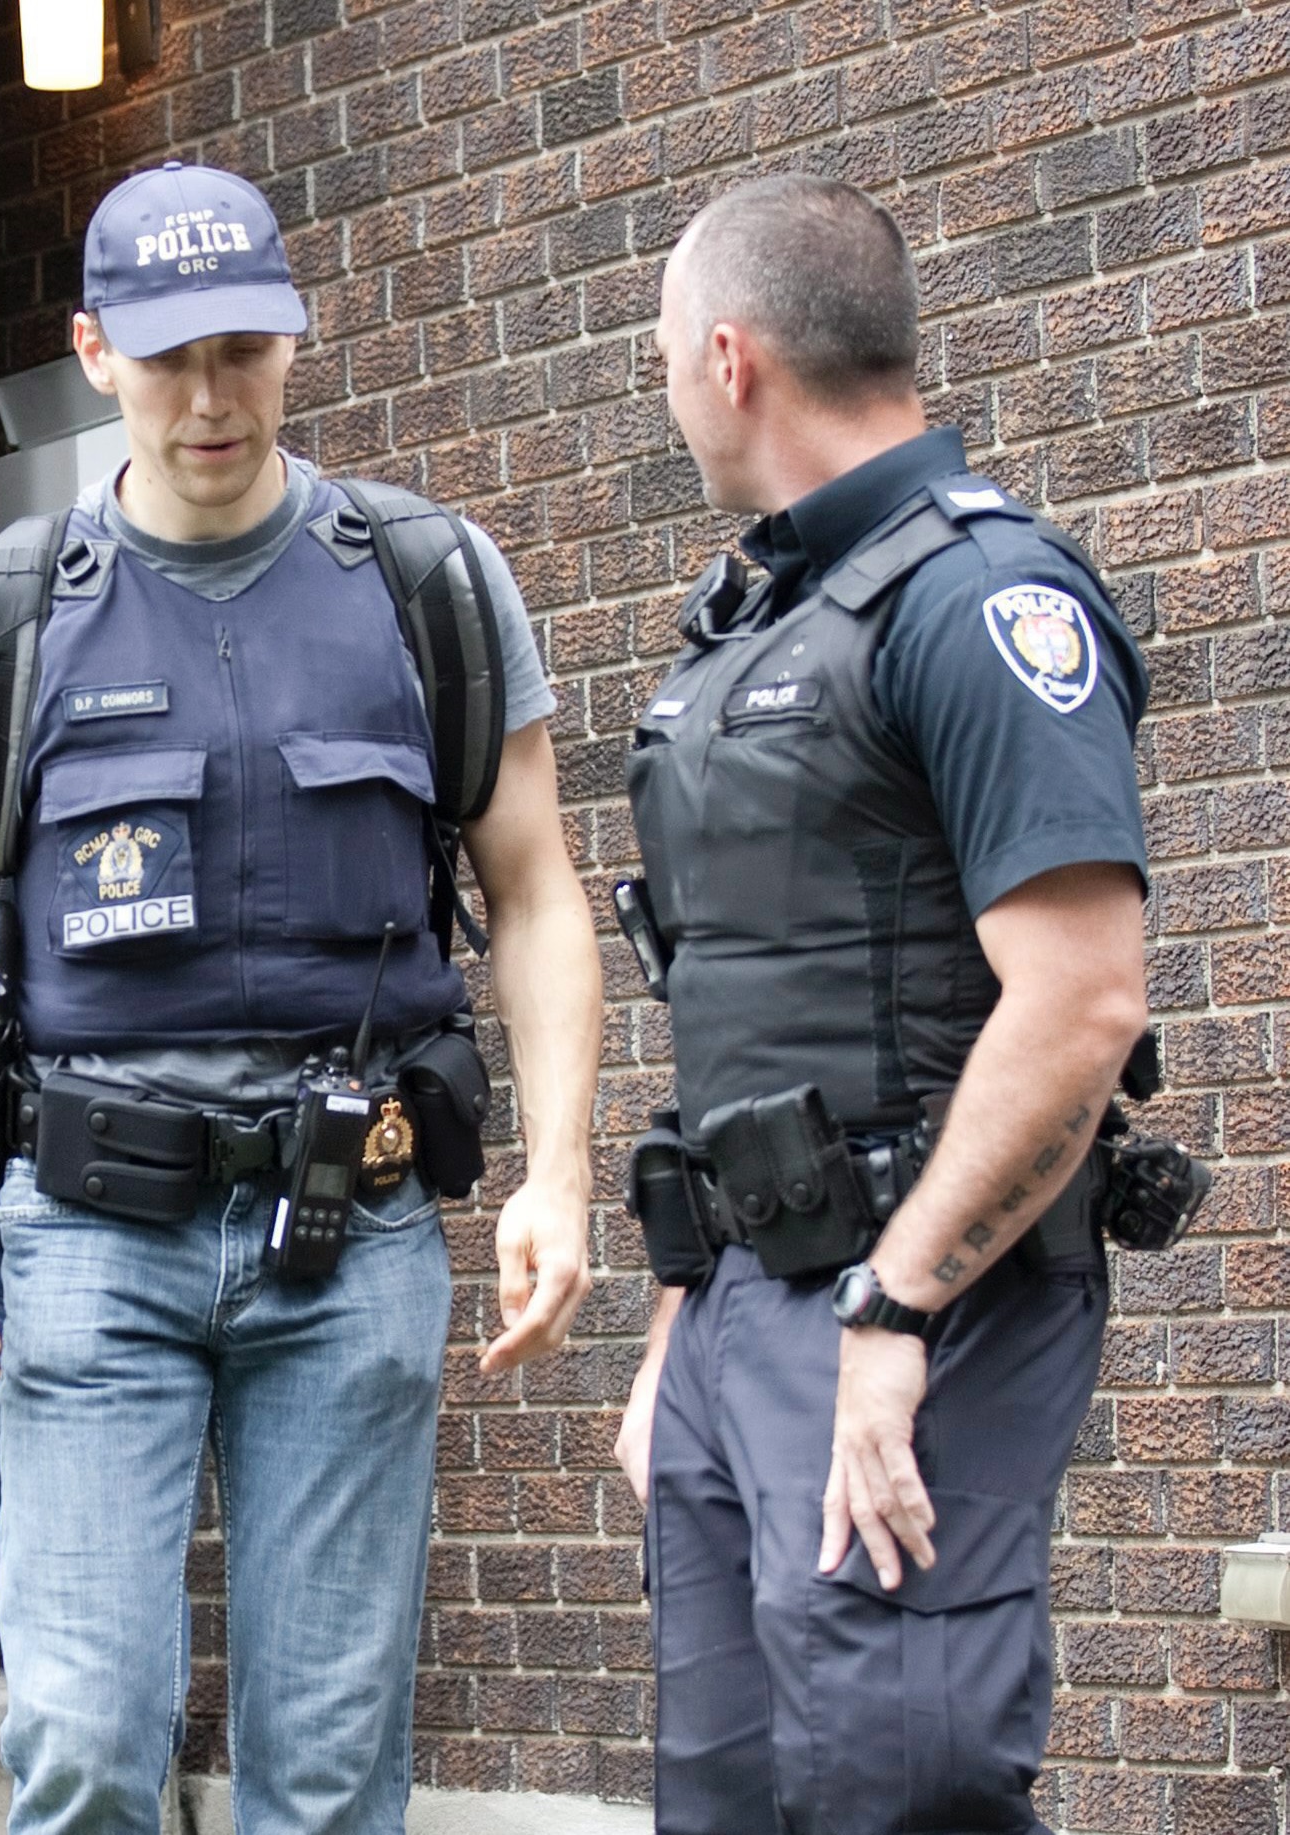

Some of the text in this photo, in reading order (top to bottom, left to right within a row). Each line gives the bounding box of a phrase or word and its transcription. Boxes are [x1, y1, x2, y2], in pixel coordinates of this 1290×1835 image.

[165, 209, 214, 227] RCMP
[135, 222, 252, 267] POLICE
[178, 256, 219, 275] GRC
[994, 593, 1075, 622] POLICE
[101, 690, 154, 708] CONNORS
[745, 685, 799, 708] POLICE
[73, 825, 161, 866] RCMP GRC
[98, 878, 141, 900] POLICE
[65, 899, 191, 942] POLICE
